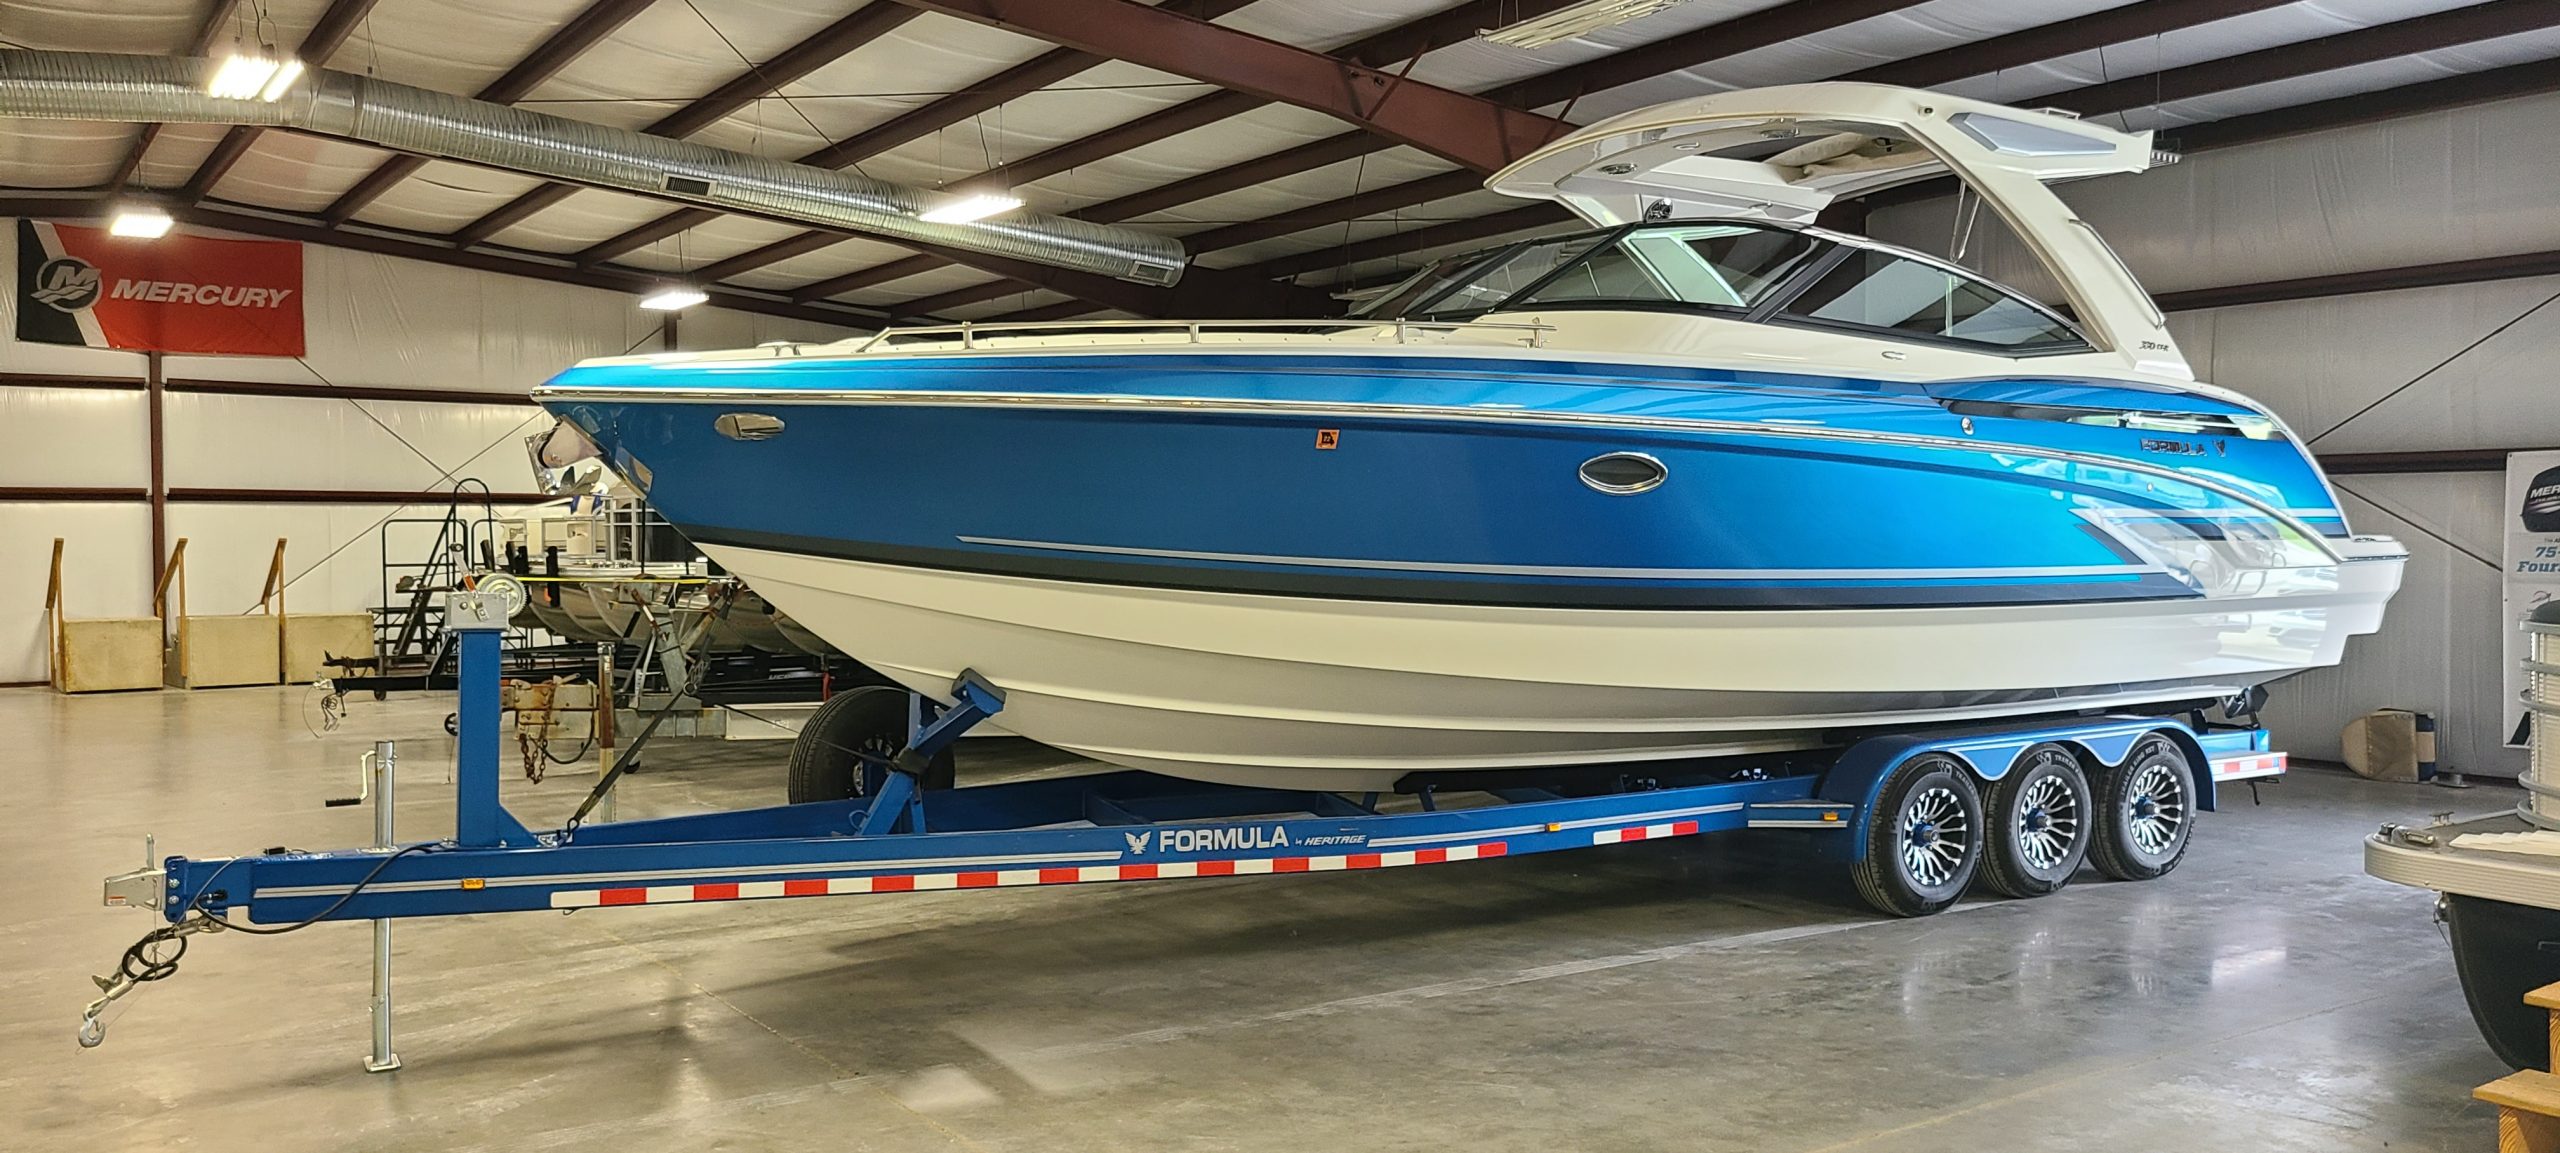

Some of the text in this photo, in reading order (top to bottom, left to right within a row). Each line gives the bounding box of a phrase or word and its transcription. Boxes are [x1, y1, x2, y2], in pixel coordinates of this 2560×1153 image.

[110, 278, 293, 309] MERCURY
[2140, 439, 2207, 456] FORMULA
[2517, 561, 2560, 572] Four
[1159, 826, 1290, 853] FORMULA
[1303, 834, 1367, 847] HERITAGE
